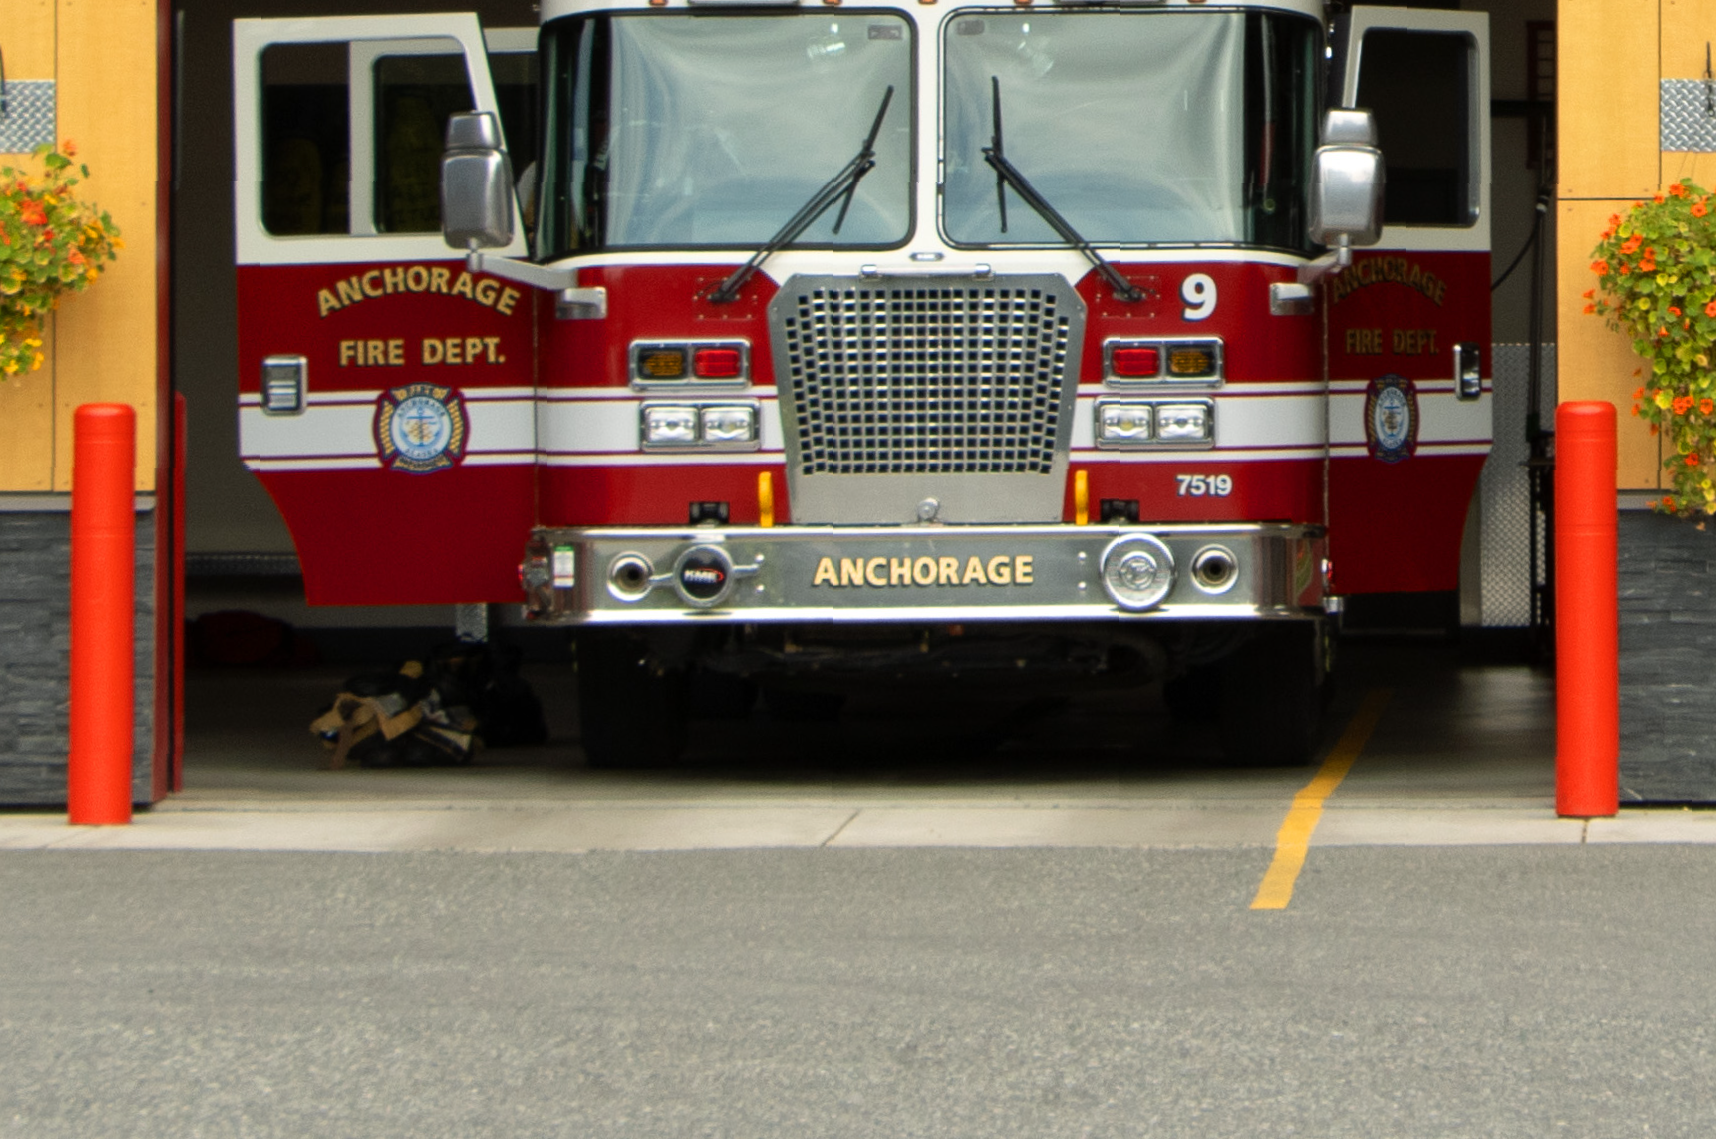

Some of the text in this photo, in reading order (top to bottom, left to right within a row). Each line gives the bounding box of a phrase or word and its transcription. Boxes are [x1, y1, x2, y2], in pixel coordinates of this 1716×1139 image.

[318, 265, 521, 317] ANCHORAGE
[1179, 272, 1218, 322] 9
[1334, 258, 1448, 305] ANCHORAGE
[339, 336, 506, 367] FIRE DEPT.
[1345, 329, 1439, 355] FIRE DEPT.
[1176, 475, 1233, 496] 7519
[813, 556, 1034, 587] ANCHORAGE
